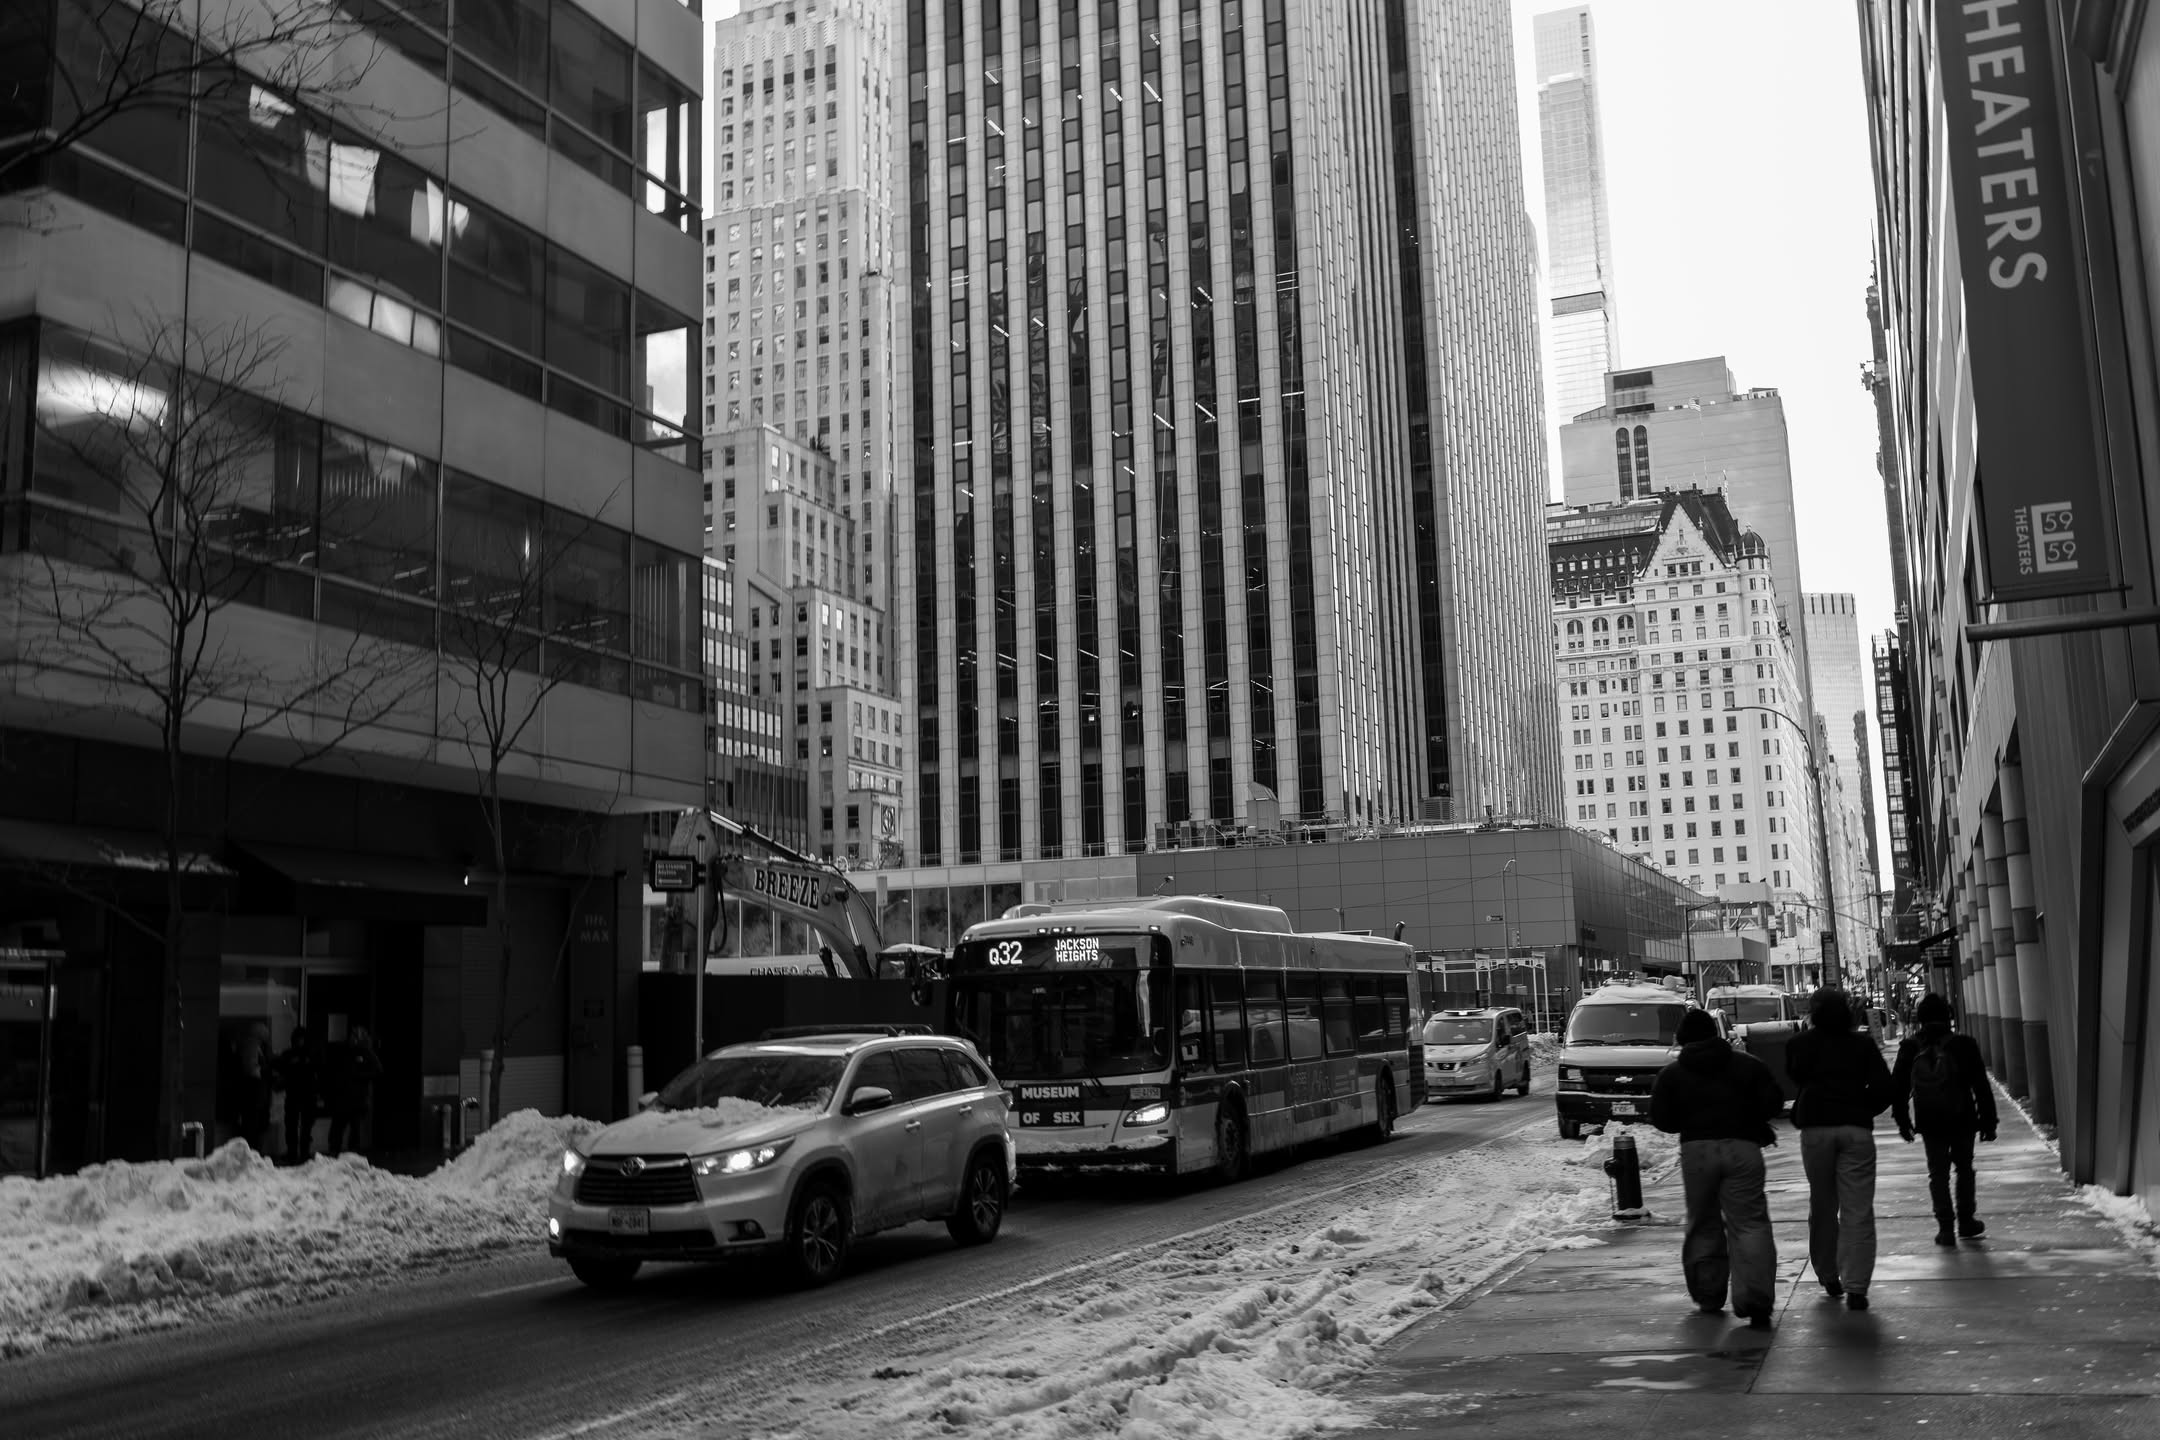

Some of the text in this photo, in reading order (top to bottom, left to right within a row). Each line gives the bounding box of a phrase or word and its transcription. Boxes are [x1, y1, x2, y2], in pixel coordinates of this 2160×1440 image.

[2044, 511, 2073, 532] 59
[2014, 506, 2033, 576] THEATERS
[2047, 541, 2077, 562] 59
[753, 867, 819, 912] BREEZE
[988, 941, 1023, 966] Q32
[1054, 937, 1100, 951] JACKSON
[1056, 950, 1099, 962] HEIGHTS
[1021, 1086, 1080, 1099] MUSEUM
[1022, 1111, 1081, 1124] OF SEX
